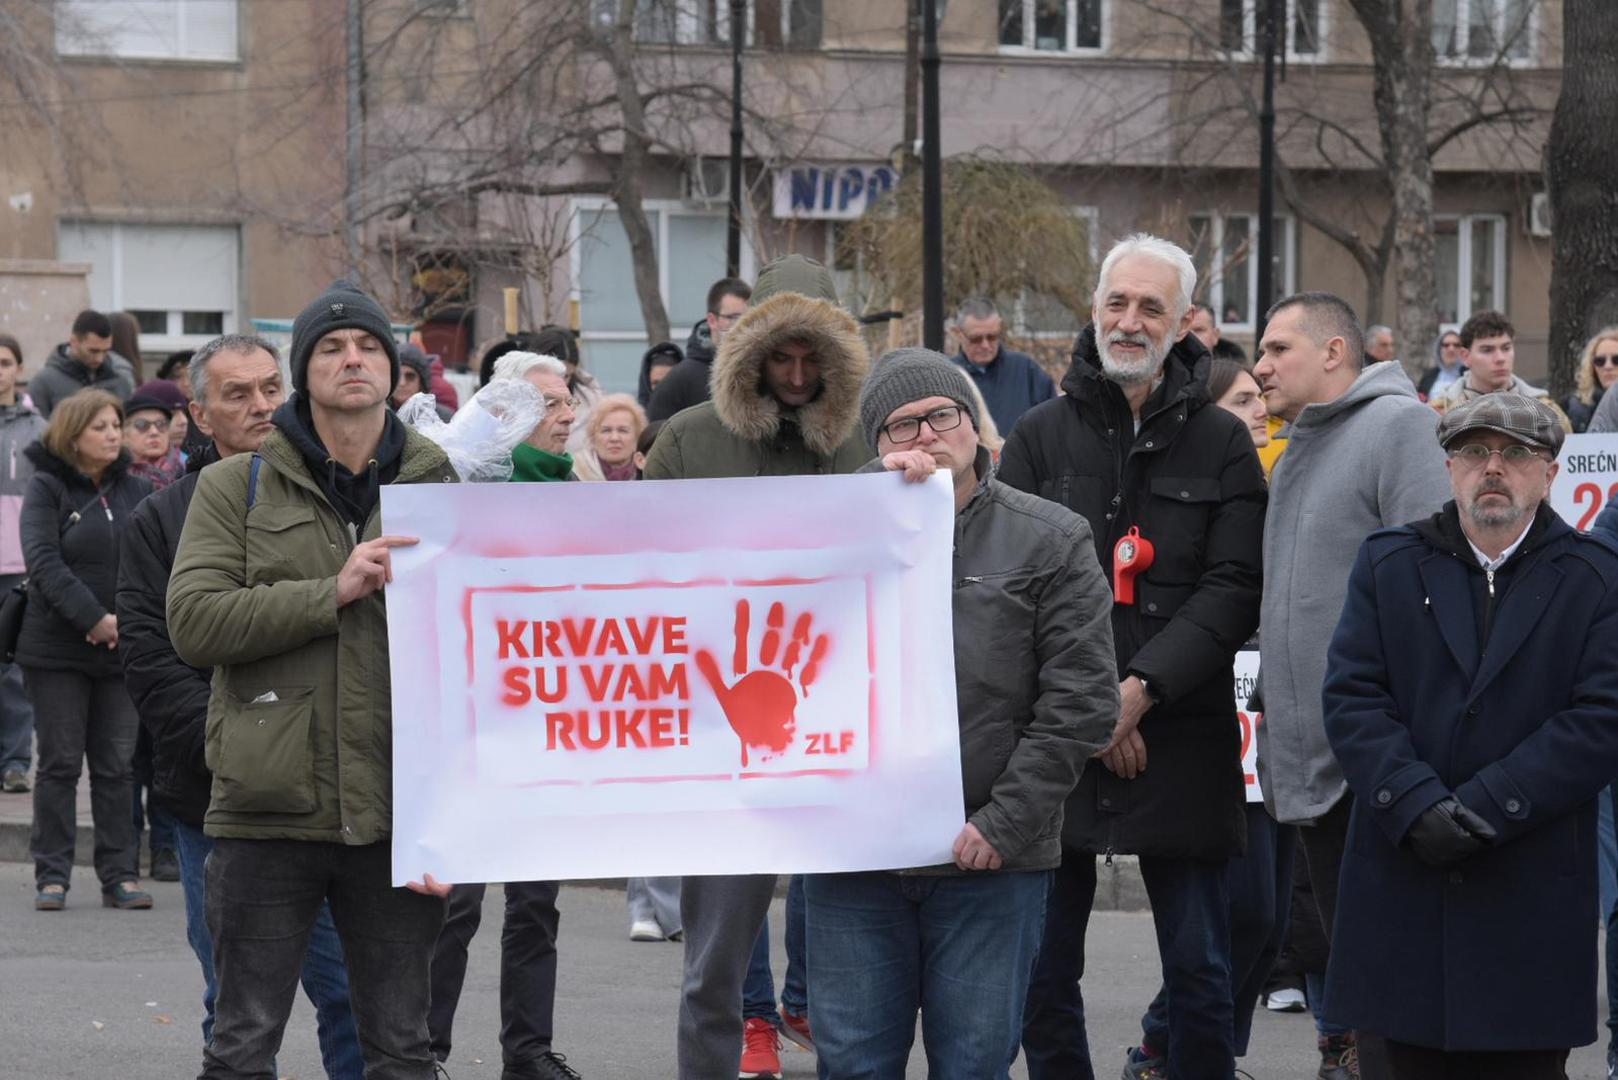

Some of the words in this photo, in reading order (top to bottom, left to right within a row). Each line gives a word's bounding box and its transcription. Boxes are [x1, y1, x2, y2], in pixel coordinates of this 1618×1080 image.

[1567, 450, 1617, 473] SREĆN
[1573, 481, 1618, 531] 2
[496, 617, 689, 658] KRVAVE
[502, 665, 568, 708] SU
[579, 662, 690, 702] VAM
[545, 708, 689, 750] RUKE!
[804, 731, 855, 754] ZLF
